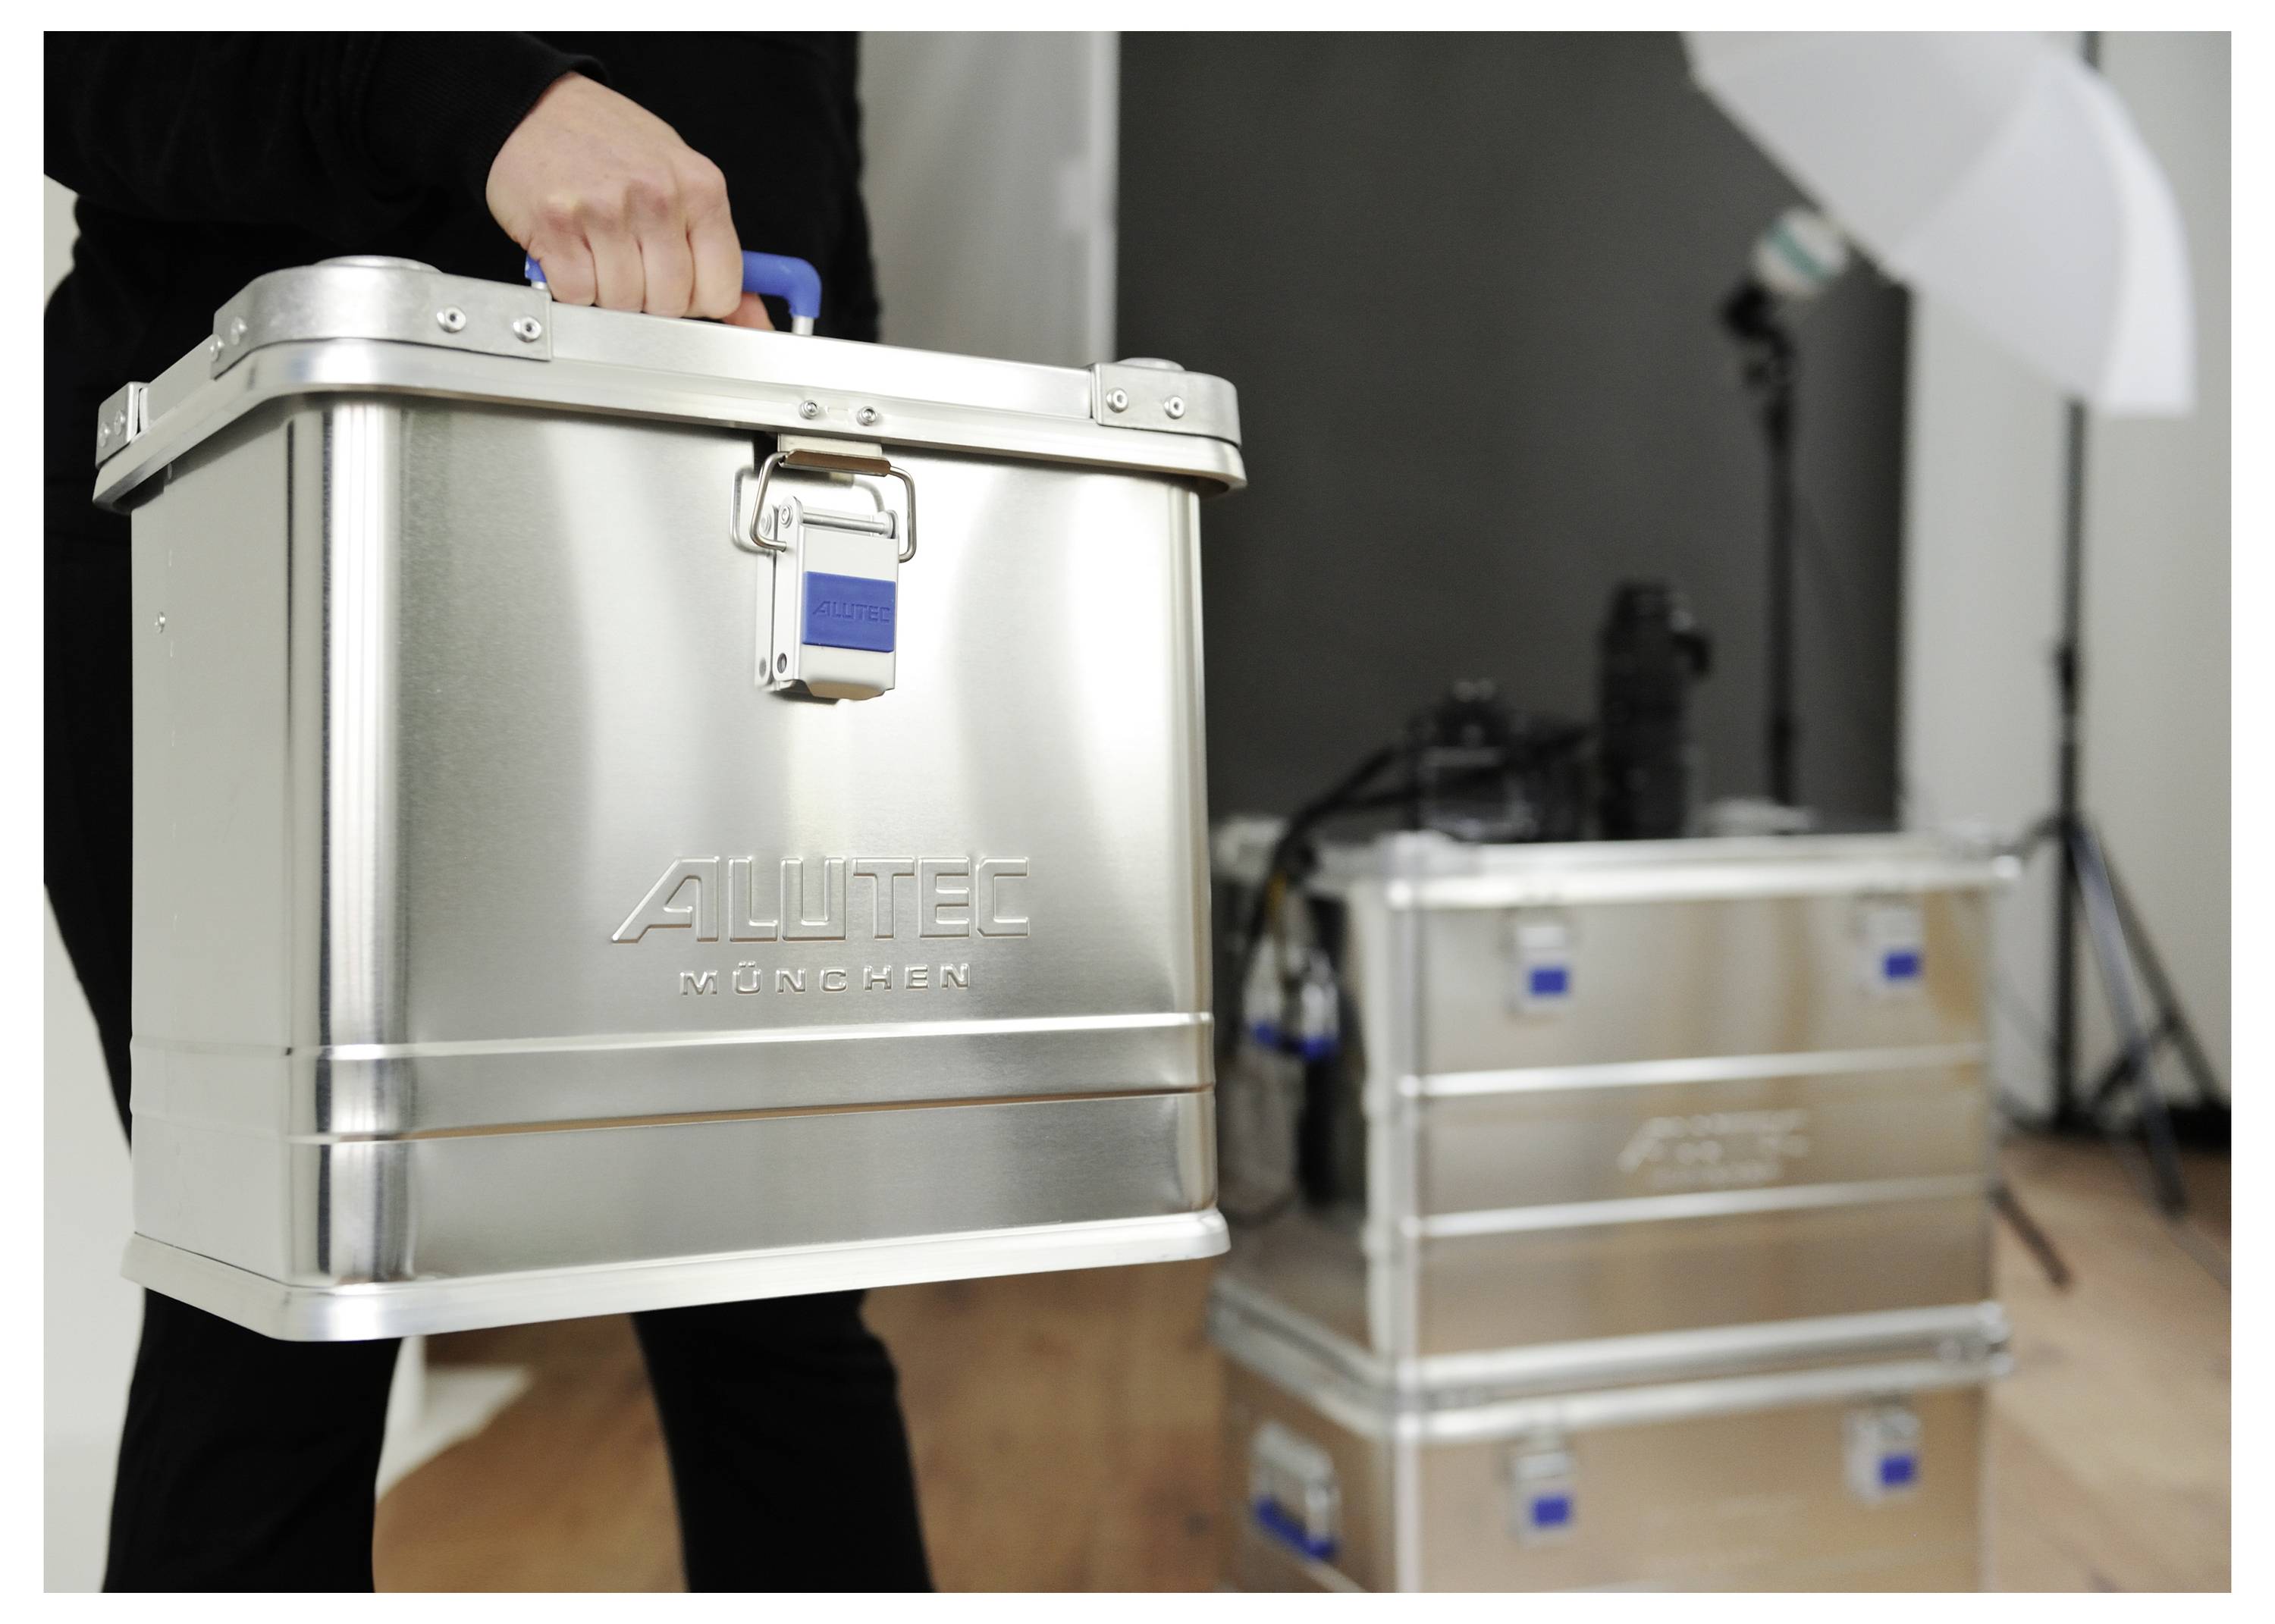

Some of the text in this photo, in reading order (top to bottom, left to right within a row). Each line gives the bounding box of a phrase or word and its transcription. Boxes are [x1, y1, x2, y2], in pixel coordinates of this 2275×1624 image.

[812, 600, 891, 623] ALUTEC
[610, 855, 1030, 943] ALUTEC
[679, 960, 971, 995] MÜNCHEN
